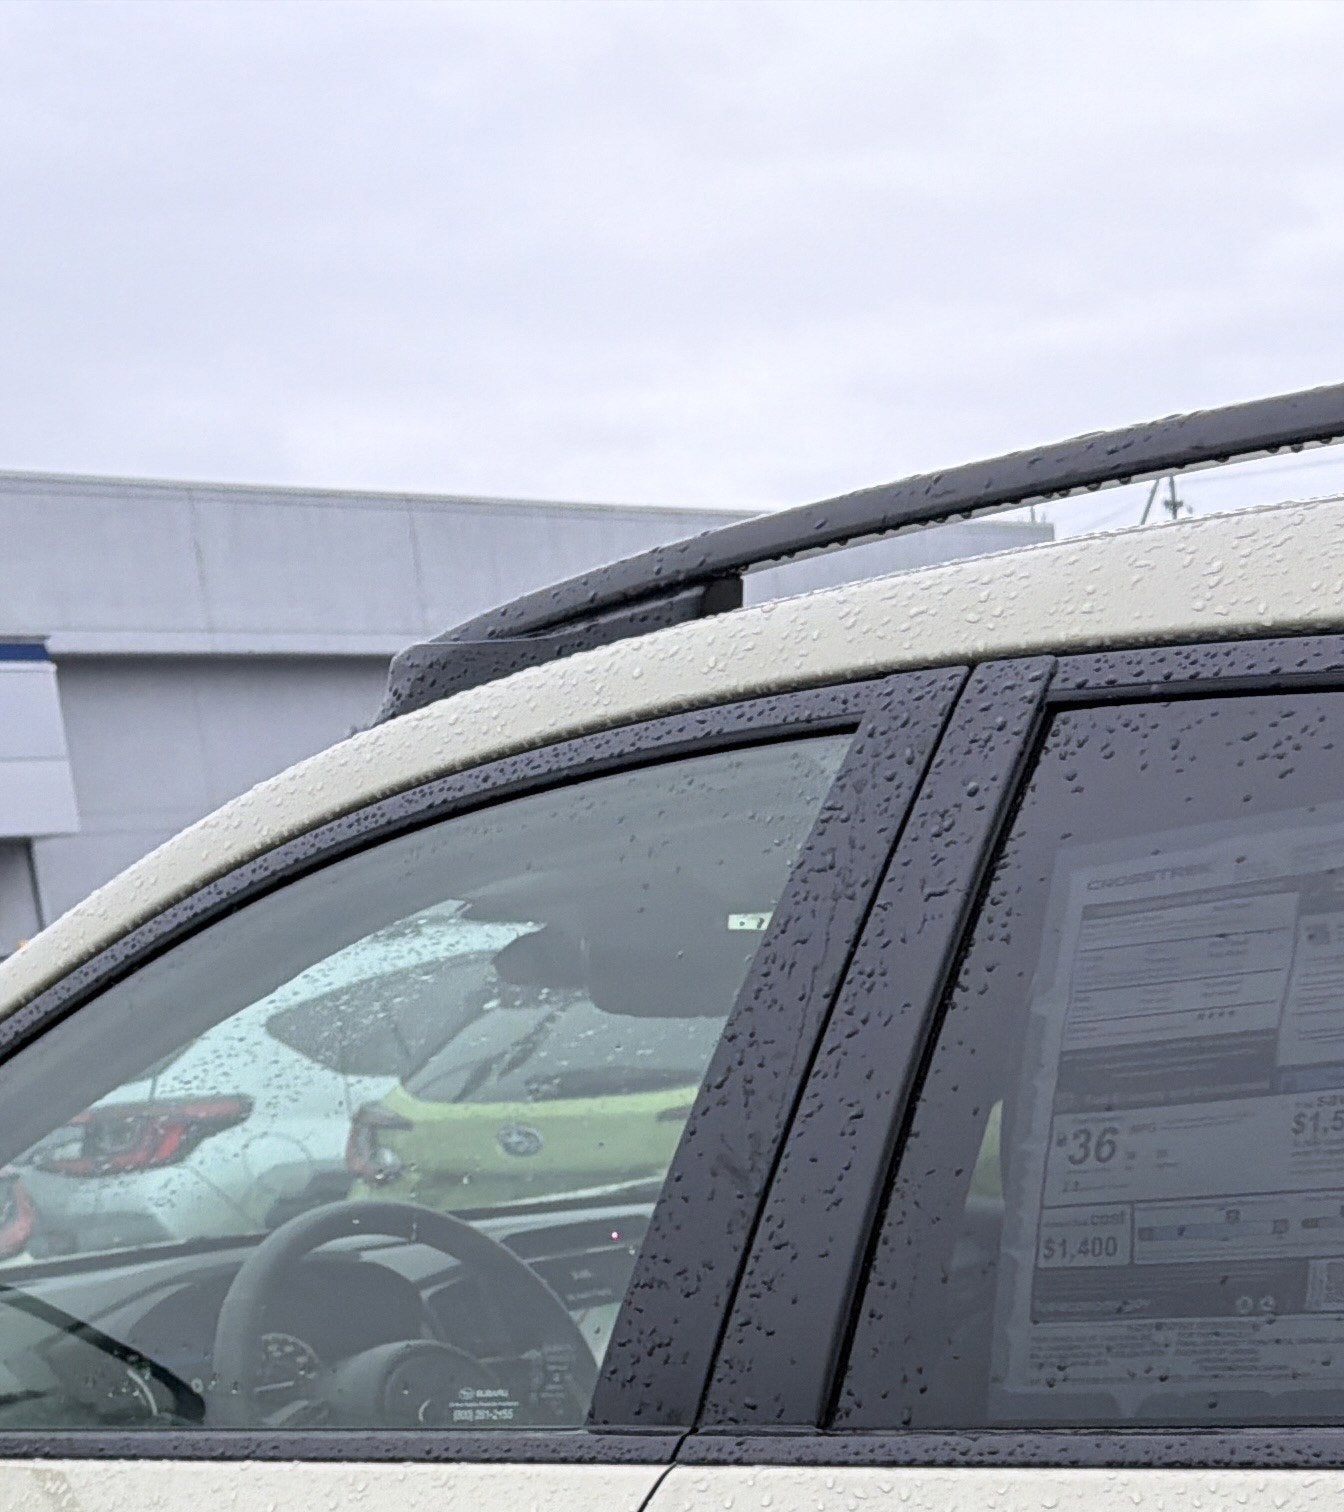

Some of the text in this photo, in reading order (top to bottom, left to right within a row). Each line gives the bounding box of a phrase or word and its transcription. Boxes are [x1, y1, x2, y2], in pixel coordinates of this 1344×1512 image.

[1068, 1126, 1119, 1166] 36
[1091, 1210, 1125, 1227] cost
[1042, 1235, 1119, 1261] $1,400
